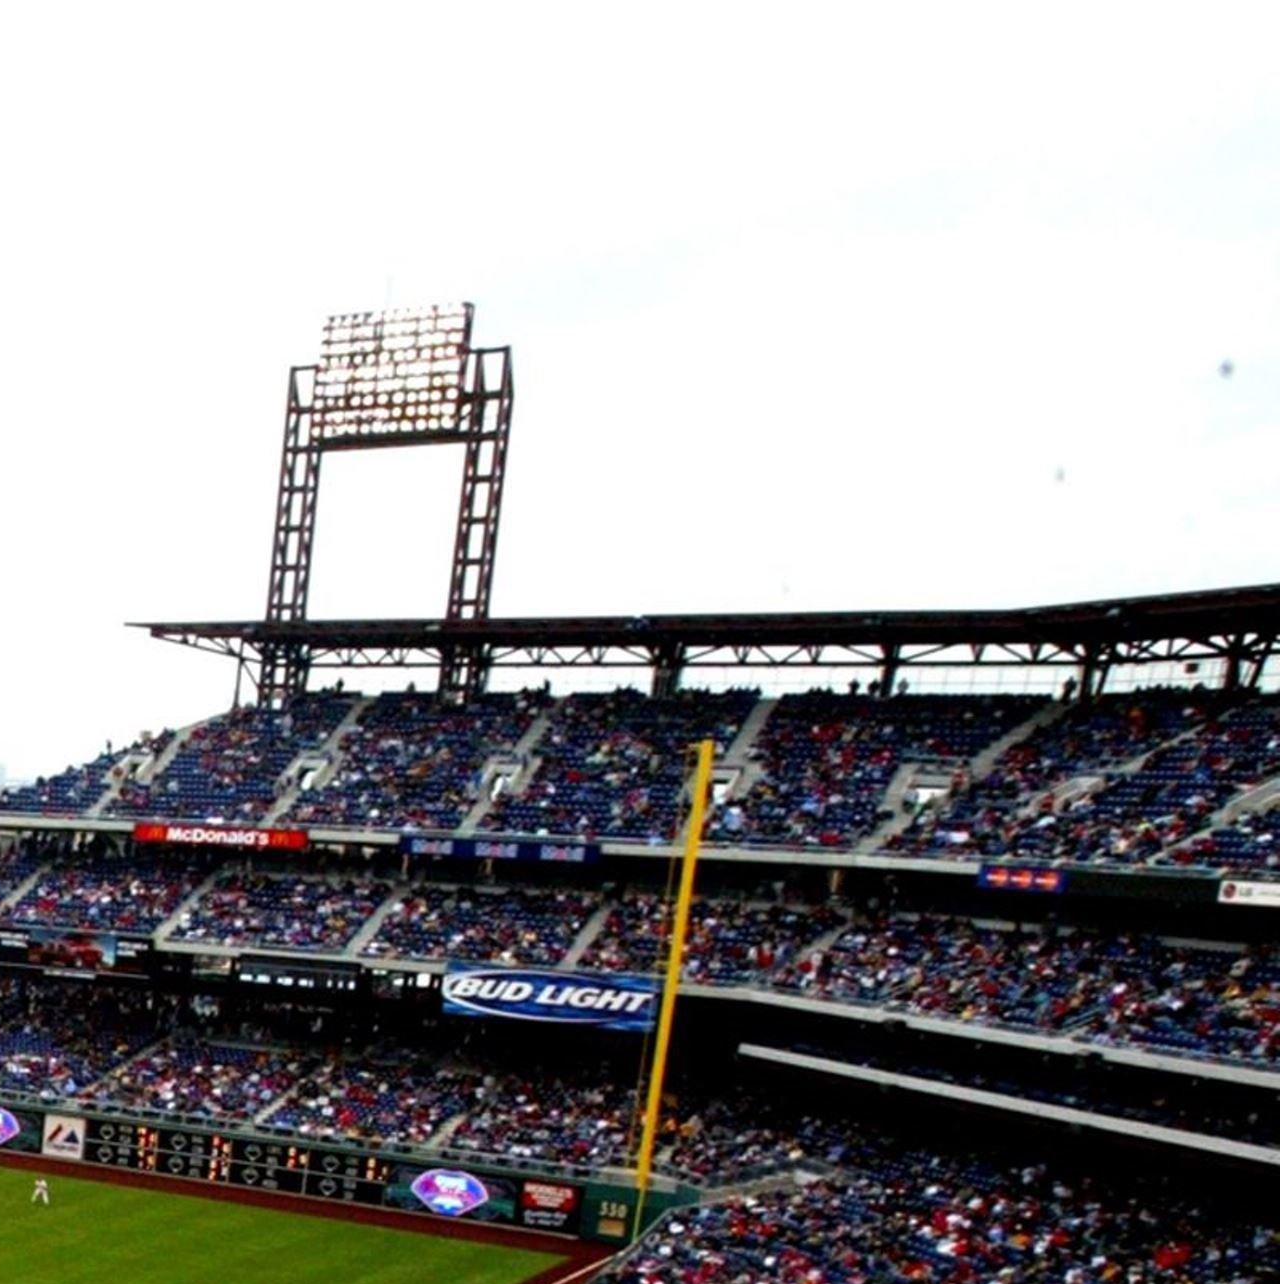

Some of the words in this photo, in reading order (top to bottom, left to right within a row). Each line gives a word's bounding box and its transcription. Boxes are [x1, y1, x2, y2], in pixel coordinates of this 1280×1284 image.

[165, 826, 270, 846] McDonald's
[451, 977, 534, 1002] BUD
[535, 984, 655, 1013] LIGHT
